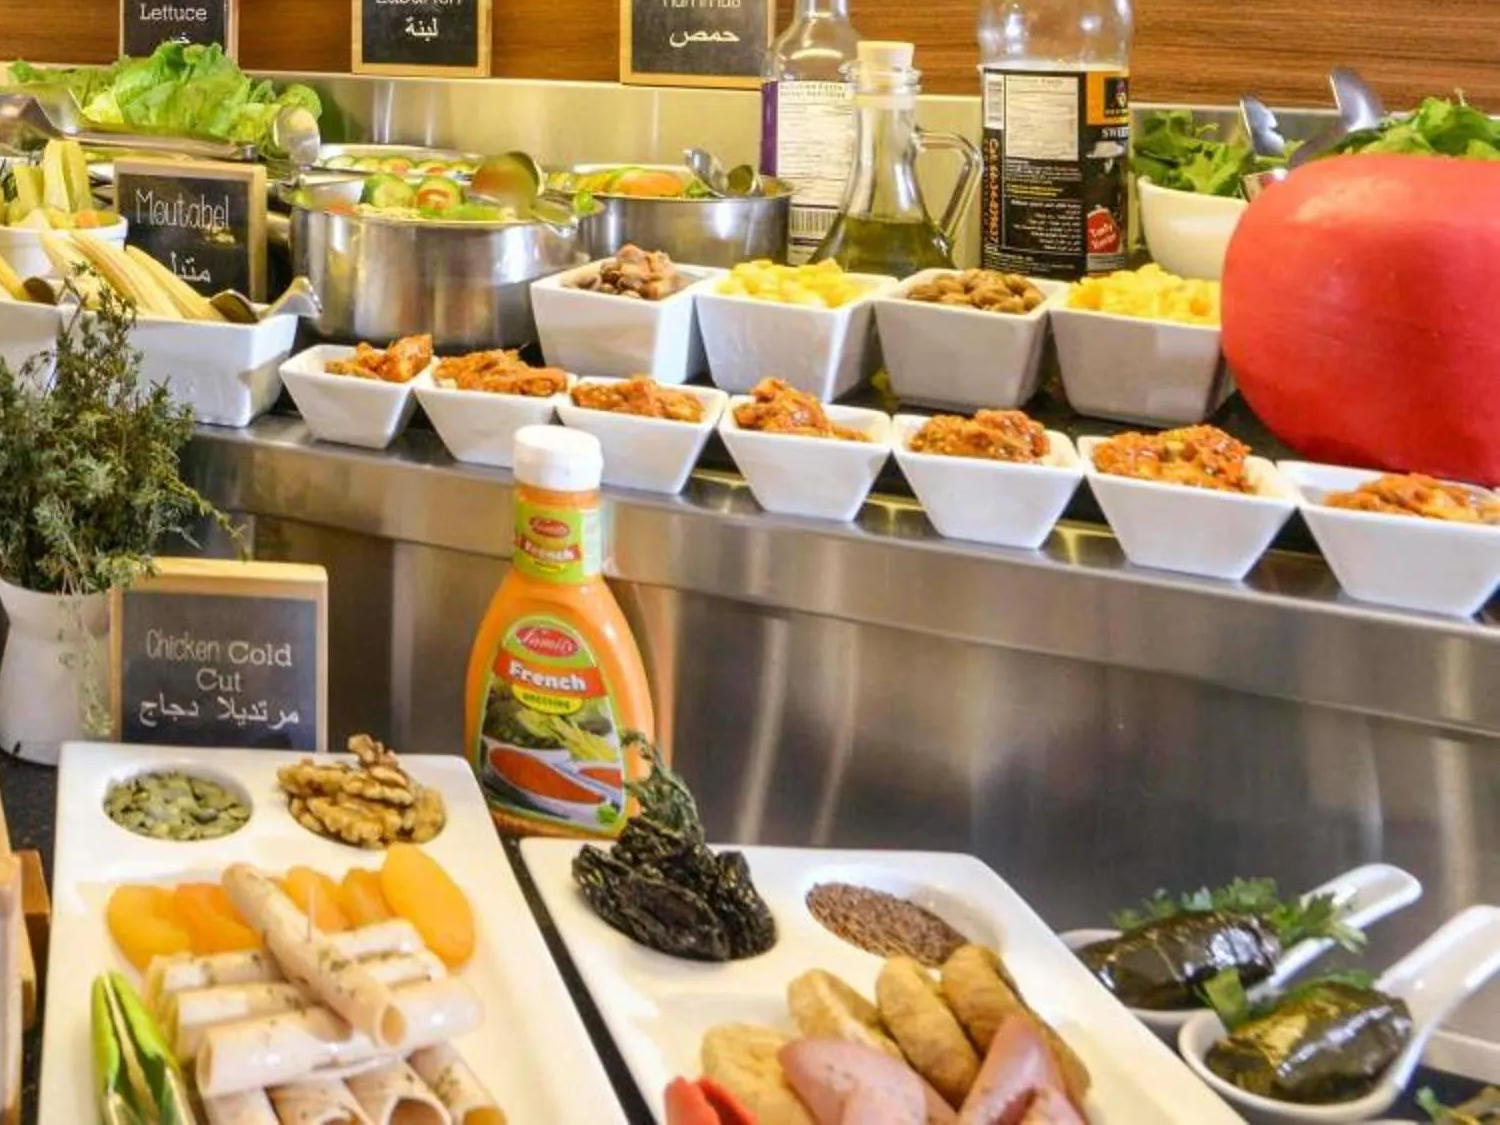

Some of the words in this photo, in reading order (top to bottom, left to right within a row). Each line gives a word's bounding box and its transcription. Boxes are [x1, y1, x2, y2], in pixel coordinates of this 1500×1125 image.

[139, 2, 208, 22] Lettuce
[404, 15, 440, 43] لبنة
[668, 29, 741, 48] حمص
[145, 628, 221, 663] Chicken
[227, 639, 294, 668] Cold
[195, 667, 242, 694] Cut
[508, 658, 588, 693] French
[139, 690, 200, 728] دجاج
[216, 695, 300, 731] مرتديلا
